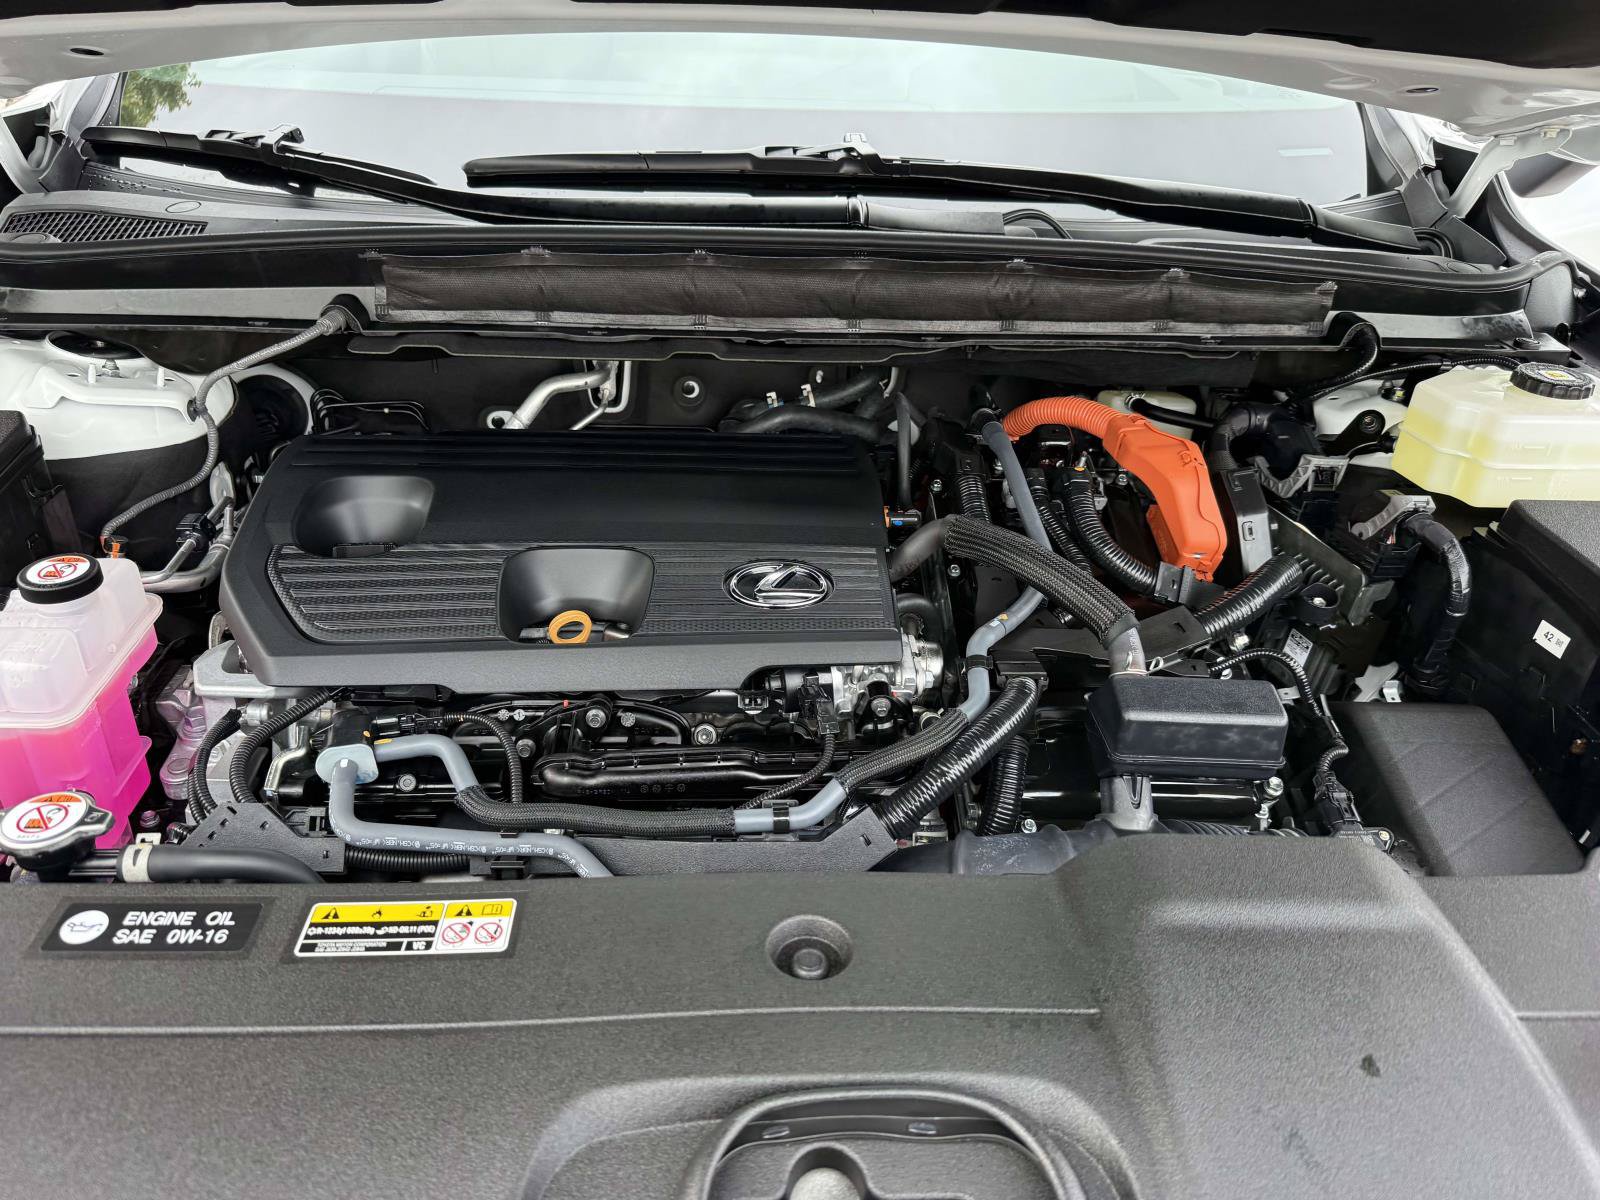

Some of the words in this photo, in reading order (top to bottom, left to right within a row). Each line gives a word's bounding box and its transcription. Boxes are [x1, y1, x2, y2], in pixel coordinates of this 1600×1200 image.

[1543, 631, 1555, 643] 42
[122, 911, 197, 926] ENGINE
[205, 911, 236, 926] OIL
[112, 928, 157, 944] SAE
[165, 928, 230, 944] 0W-16
